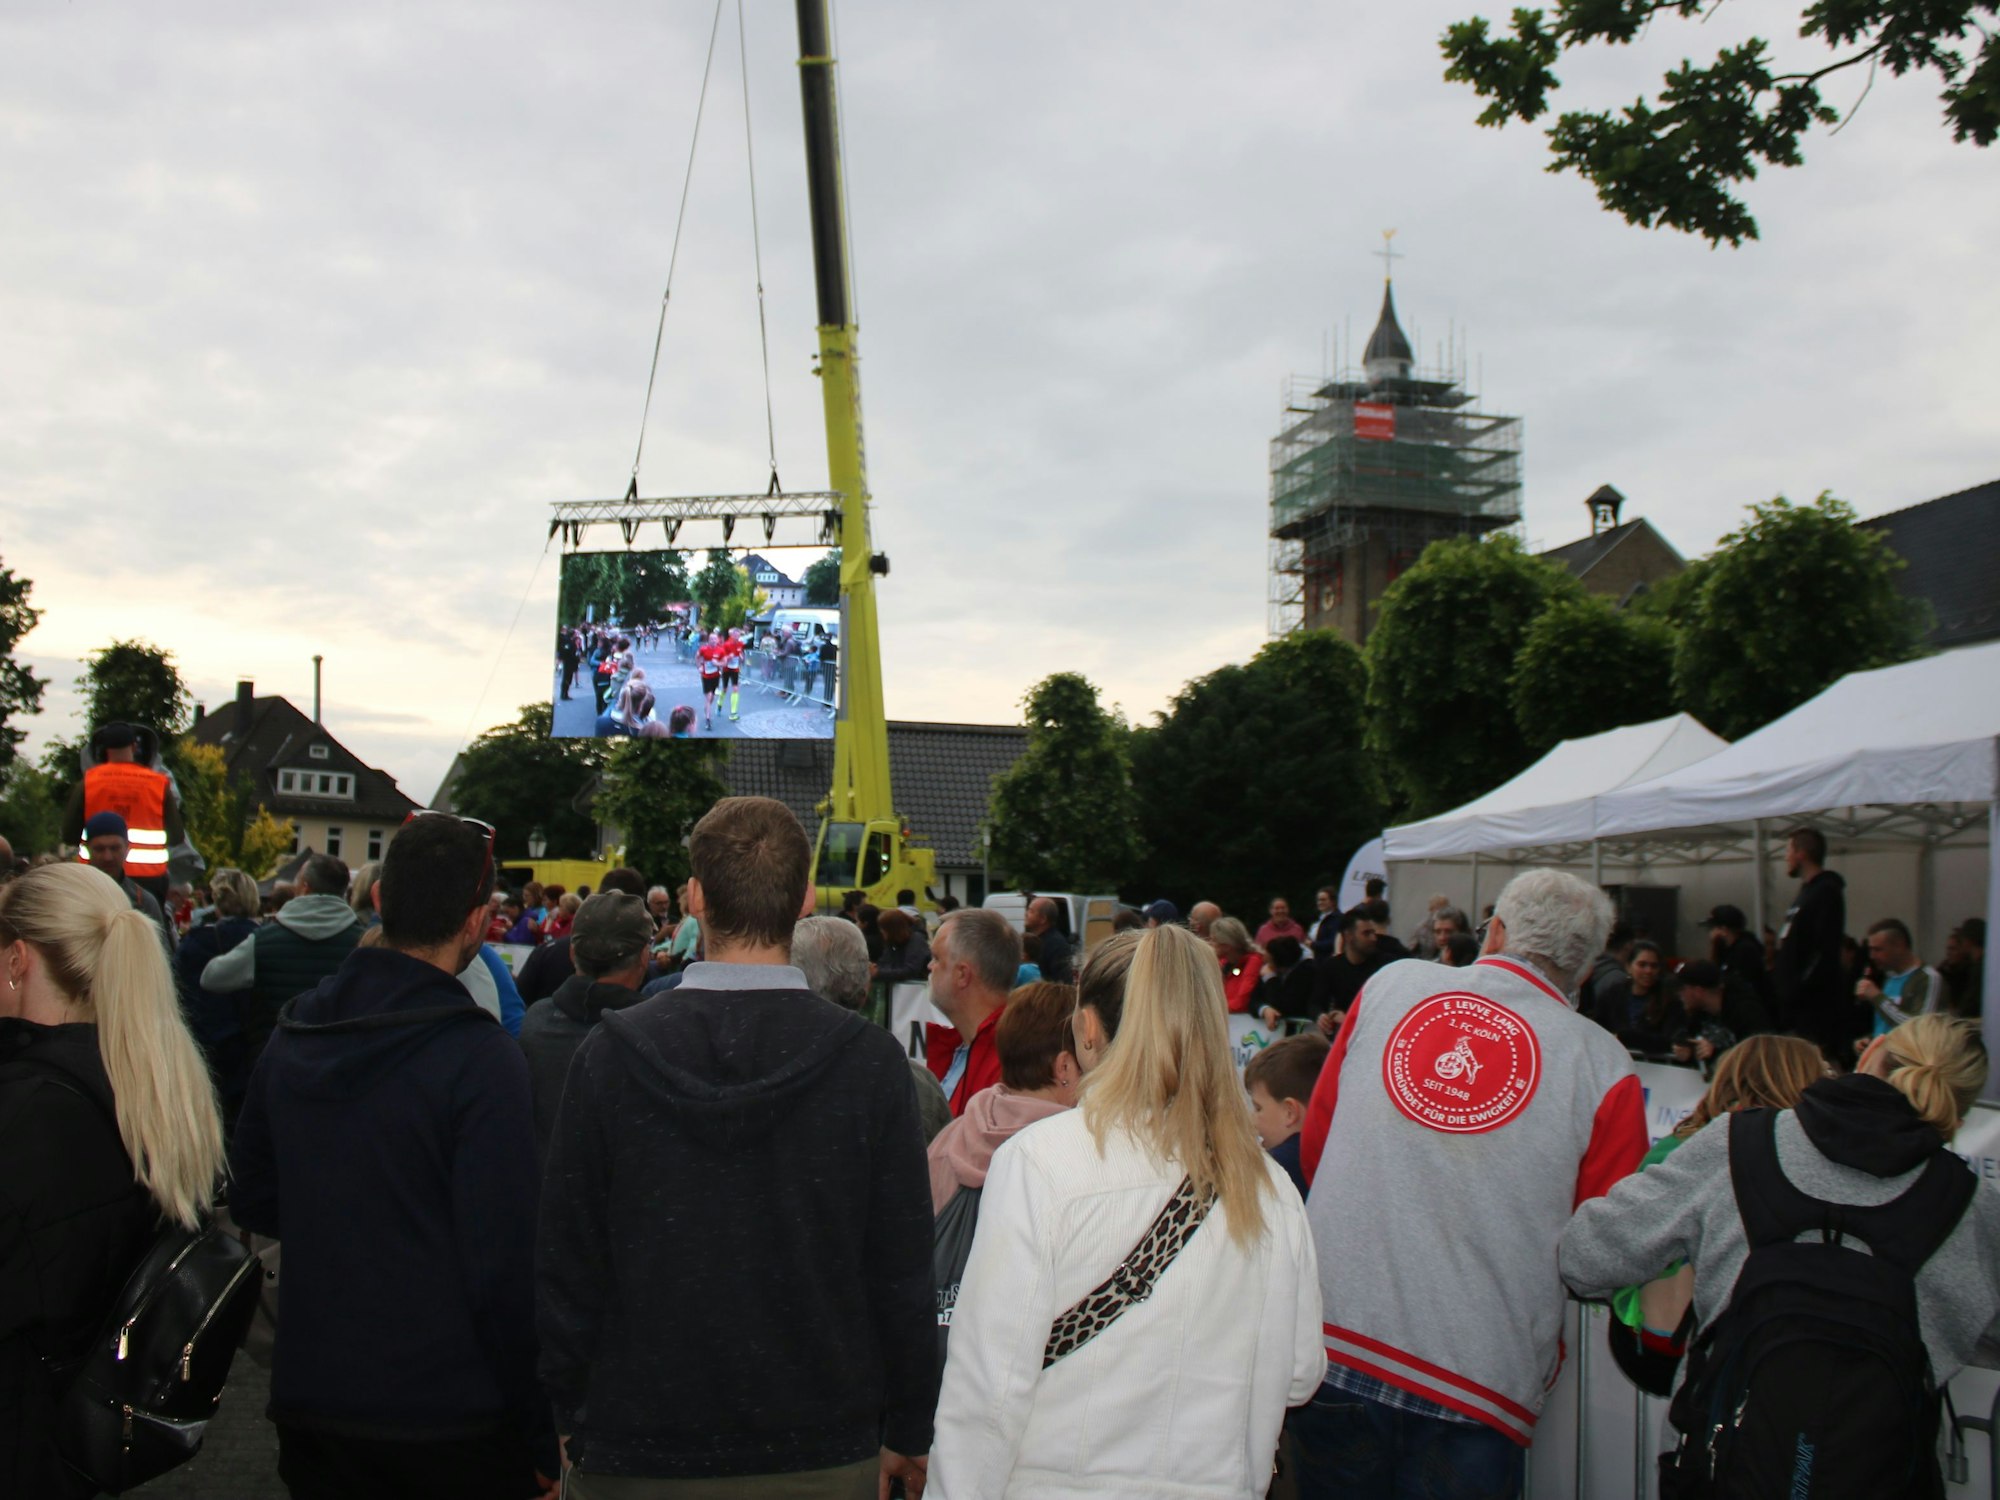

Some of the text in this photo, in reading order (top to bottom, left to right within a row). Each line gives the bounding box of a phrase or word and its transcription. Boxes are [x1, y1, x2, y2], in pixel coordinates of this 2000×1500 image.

[1443, 1001, 1520, 1036] E LEVVE LANG
[1448, 1019, 1501, 1042] 1. FC KÖLN
[1394, 1053, 1517, 1124] GEGRÜNDET FÜR DIE EWIGKEIT
[1422, 1078, 1470, 1101] SEIT 1948
